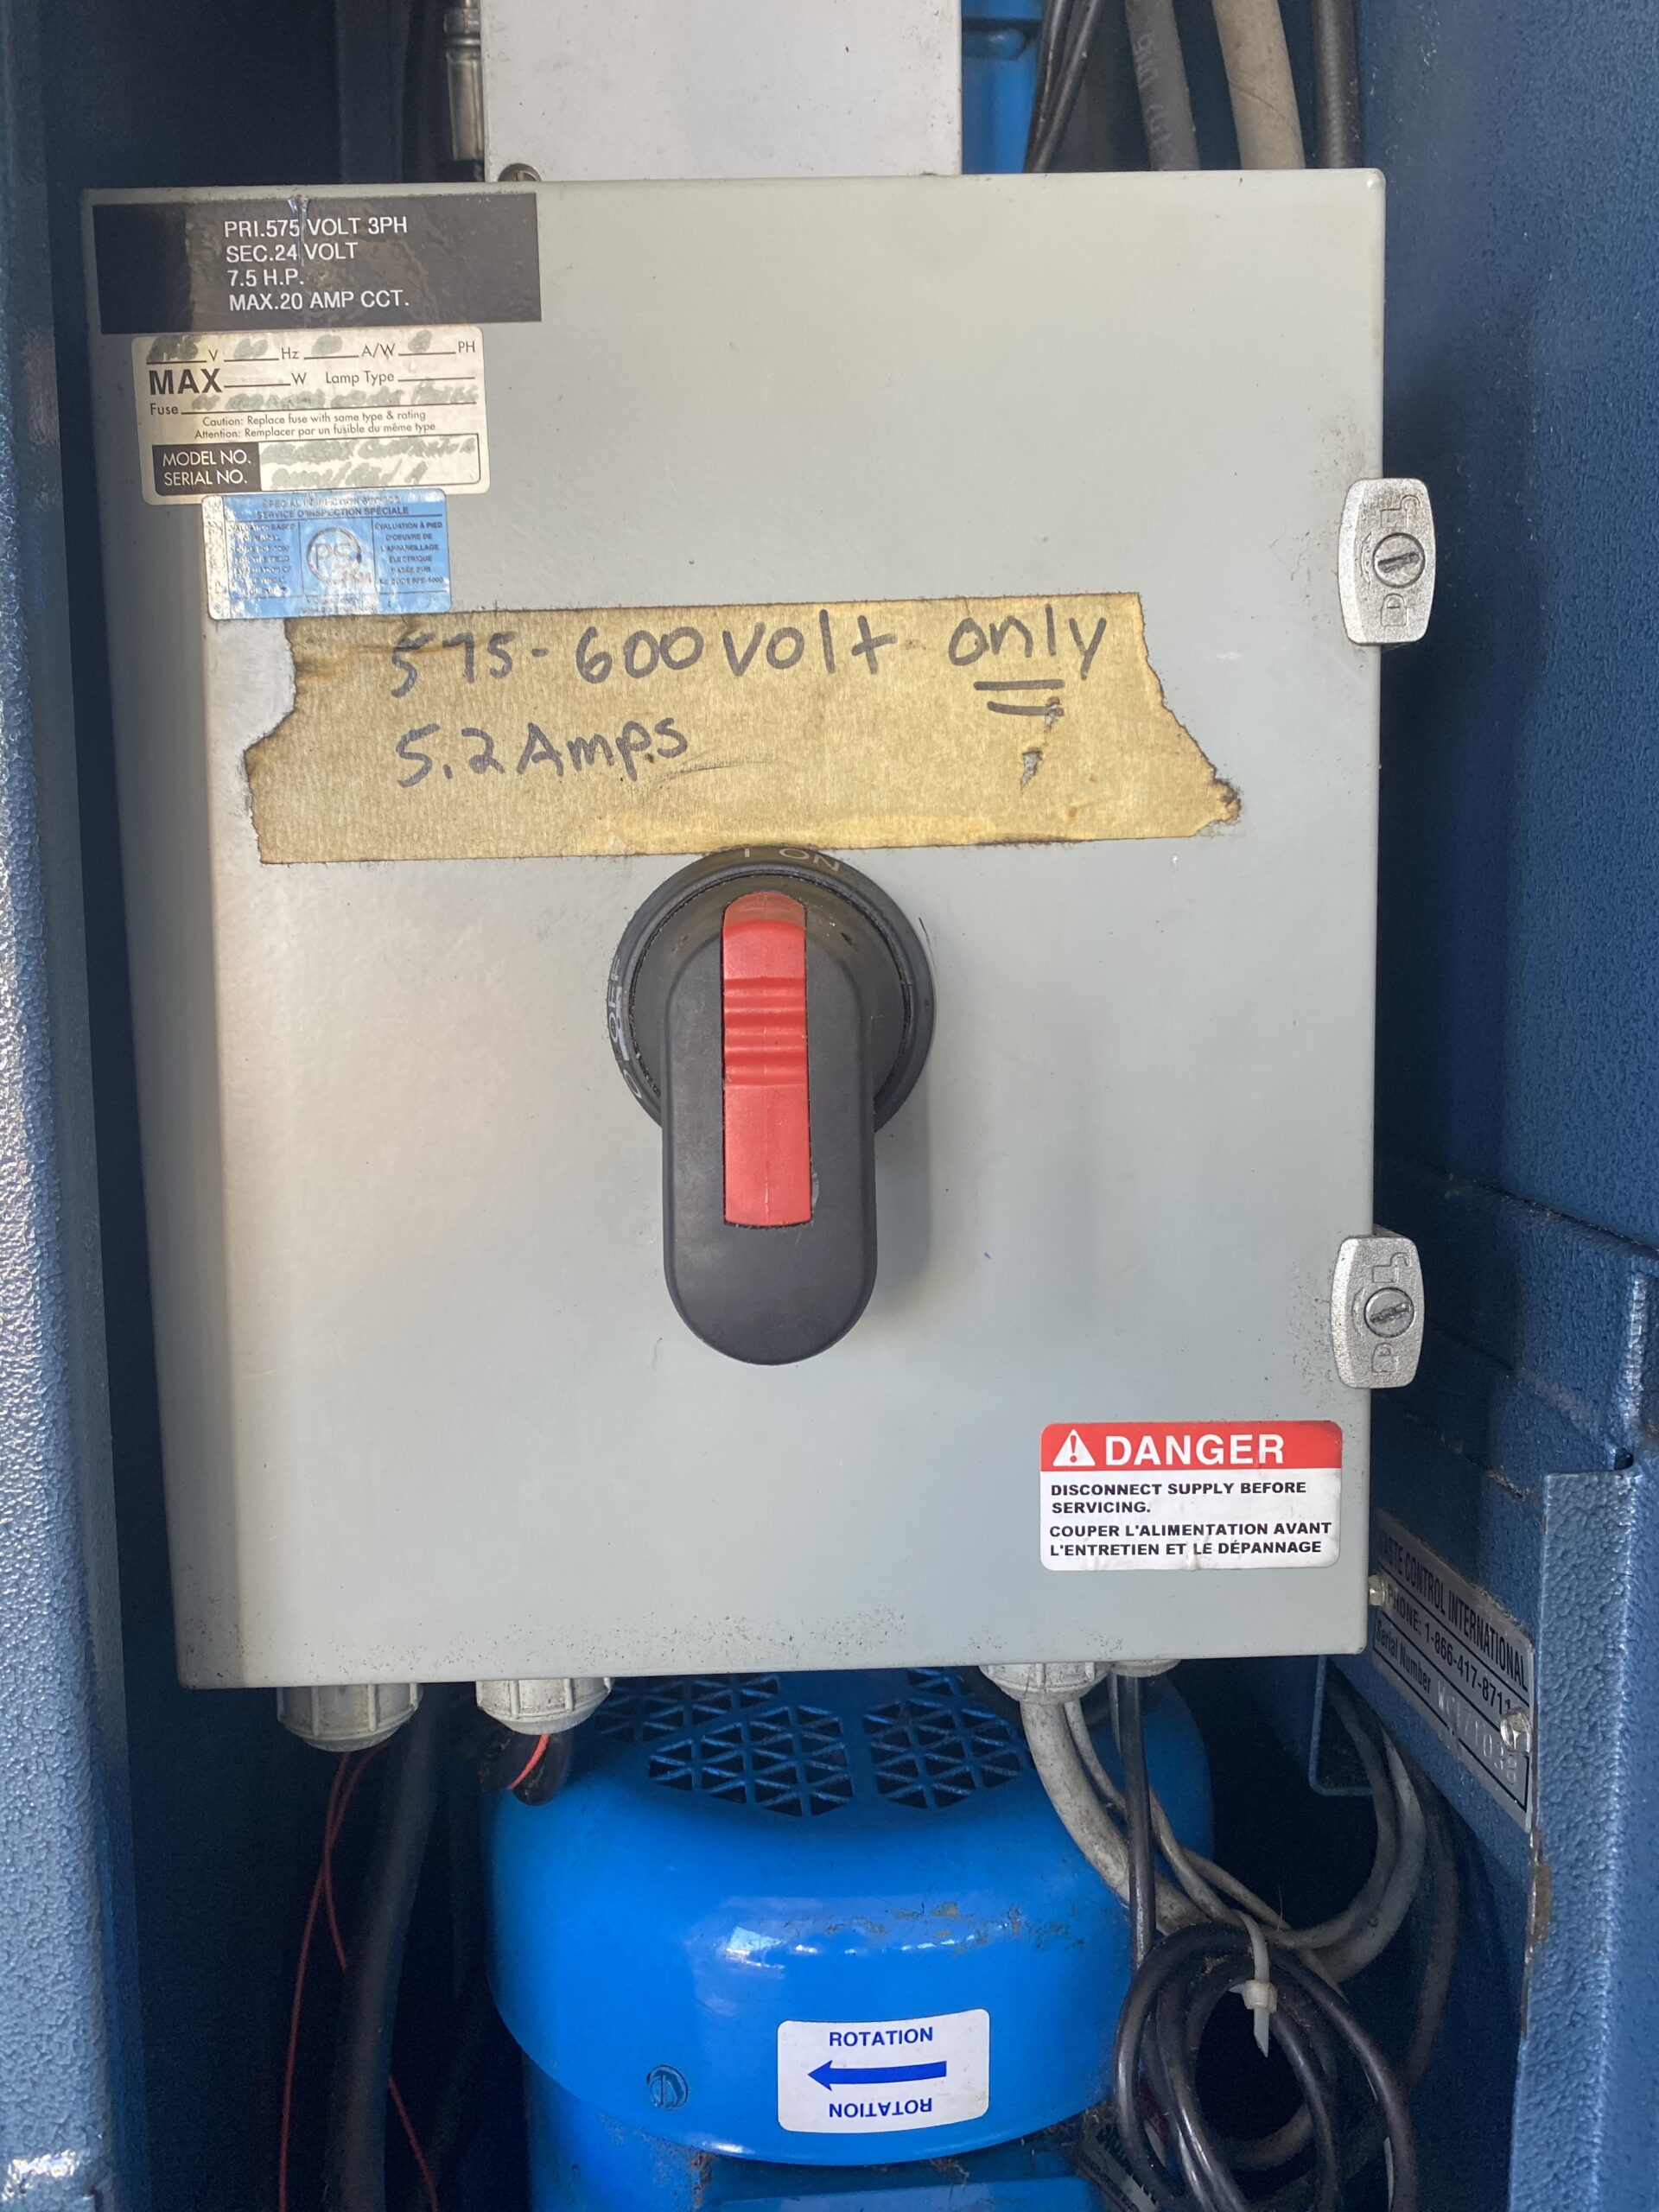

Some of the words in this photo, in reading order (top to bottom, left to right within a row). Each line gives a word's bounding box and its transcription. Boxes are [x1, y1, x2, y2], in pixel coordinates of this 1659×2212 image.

[224, 219, 301, 238] PRI.575
[307, 218, 361, 236] VOLT
[368, 216, 408, 235] 3PH
[226, 244, 297, 263] SEC.24
[304, 242, 358, 260] VOLT
[227, 270, 257, 287] 7.5
[264, 268, 304, 285] H.P.
[229, 292, 303, 311] MAX.20
[309, 291, 354, 309] AMP
[360, 289, 410, 308] CCT.
[208, 349, 218, 362] V
[281, 346, 300, 360] Hz
[361, 342, 396, 358] A/W
[458, 340, 475, 353] PH
[149, 368, 223, 395] MAX
[291, 372, 307, 385] W
[326, 371, 359, 386] Lamp
[364, 370, 394, 386] Type
[149, 403, 179, 415] Fuse
[202, 416, 244, 427] Caution:
[247, 415, 285, 427] Replace
[288, 413, 308, 423] fuse
[310, 412, 331, 423] with
[334, 414, 359, 423] same
[362, 412, 383, 424] type
[386, 410, 394, 420] &
[397, 410, 426, 422] rating
[194, 429, 241, 440] Attention:
[245, 427, 295, 439] Remplacer
[298, 427, 314, 438] par
[334, 424, 365, 435] fusible
[368, 422, 380, 433] du
[383, 423, 412, 432] même
[416, 422, 435, 435] type
[162, 450, 216, 467] MODEL
[220, 448, 251, 464] NO.
[164, 470, 213, 486] SERIAL
[217, 468, 247, 485] NO.
[948, 604, 1109, 681] only
[779, 847, 840, 873] ON
[1105, 1433, 1285, 1466] DANGER
[1051, 1484, 1162, 1496] DISCONNECT
[1167, 1482, 1235, 1495] SUPPLY
[1240, 1481, 1306, 1494] BEFORE
[1052, 1501, 1151, 1514] SERVICING.
[1050, 1524, 1120, 1537] COUPER
[1125, 1523, 1268, 1537] L'ALIMENTATION
[1273, 1522, 1332, 1535] AVANT
[1051, 1542, 1160, 1556] L'ENTRETIEN
[1166, 1543, 1186, 1555] ET
[1192, 1542, 1212, 1555] LE
[1217, 1539, 1322, 1554] DÉPANNAGE
[1388, 1583, 1421, 1636] PHONE:
[1406, 1552, 1446, 1615] CONTROL
[1448, 1590, 1528, 1693] INTERNATIONAL
[1376, 1618, 1398, 1660] Serial
[1400, 1643, 1431, 1694] Number
[829, 2026, 933, 2047] ROTATION
[829, 2098, 932, 2118] ROTATION
